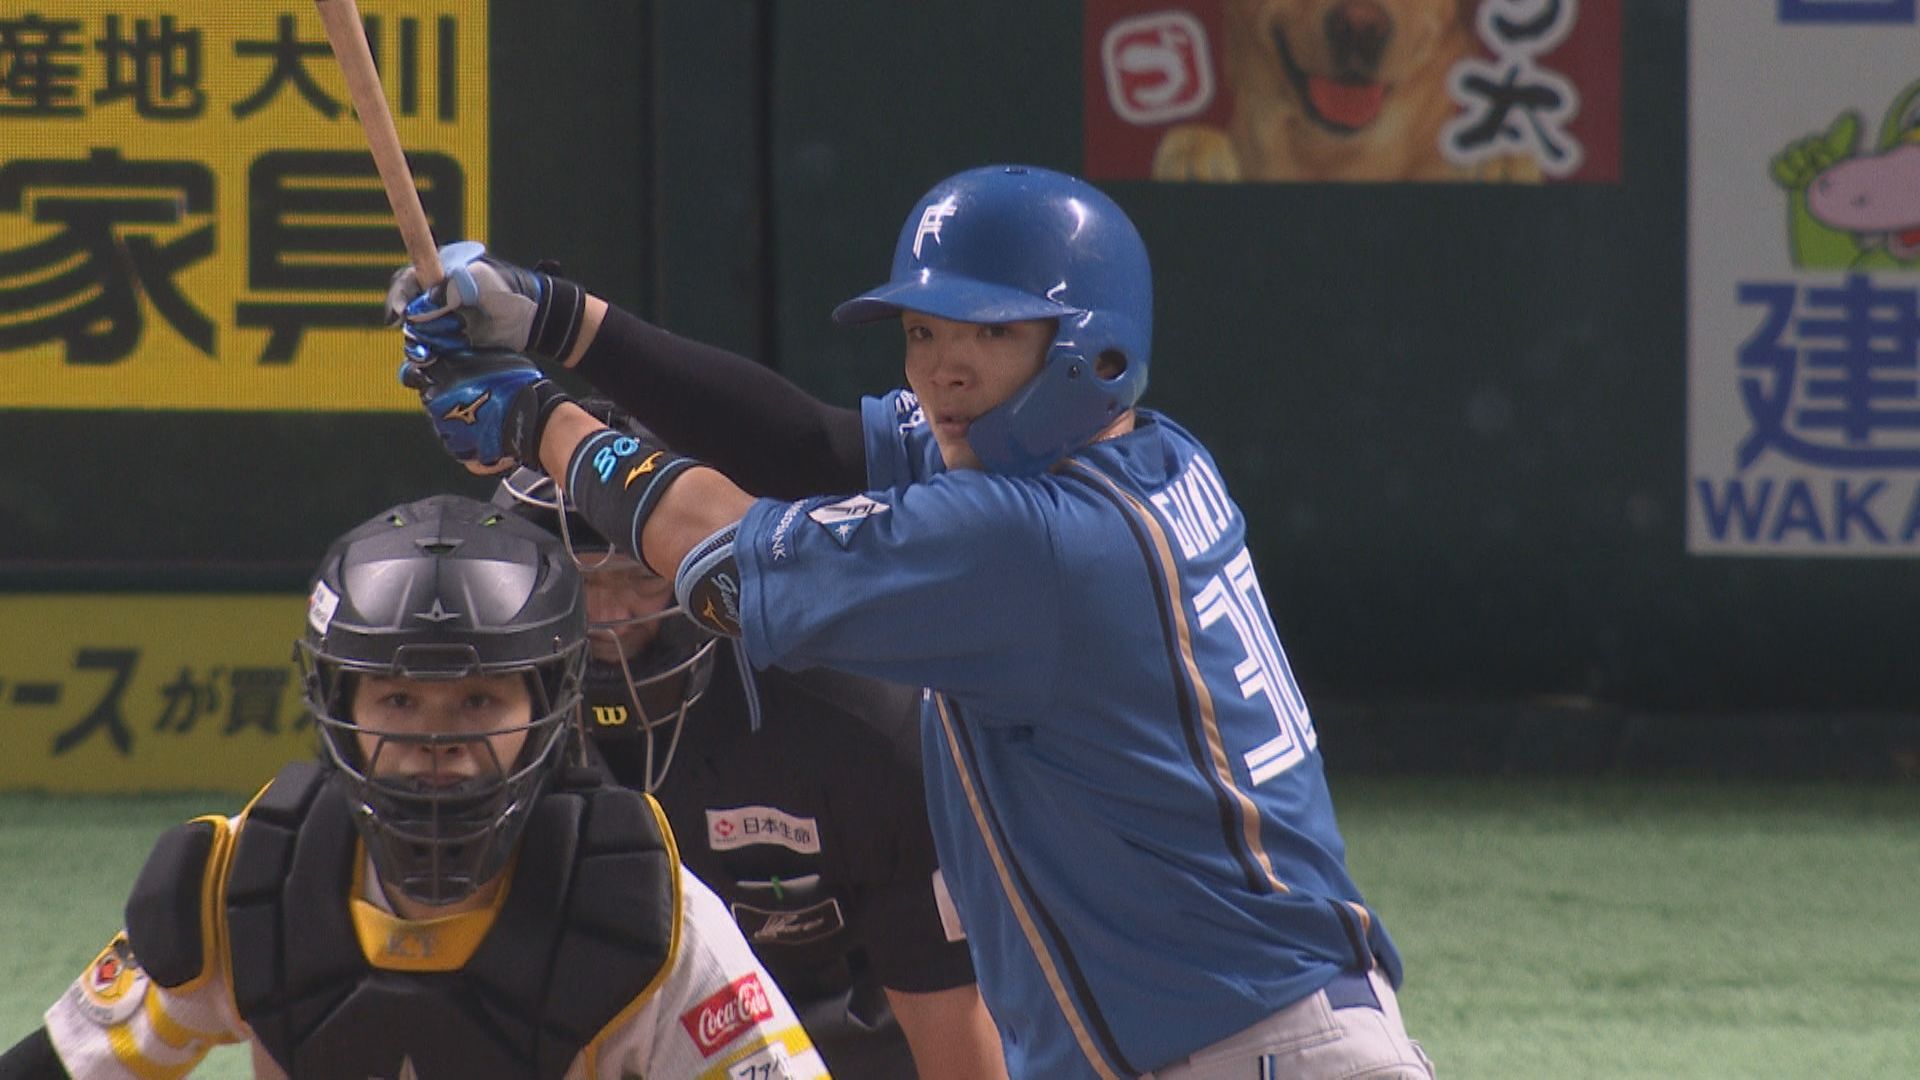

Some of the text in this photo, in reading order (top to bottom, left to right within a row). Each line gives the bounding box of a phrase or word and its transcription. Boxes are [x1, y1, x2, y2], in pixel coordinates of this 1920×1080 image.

[0, 148, 463, 366] 家具
[1192, 546, 1318, 786] 30
[743, 816, 812, 845] 日本生命
